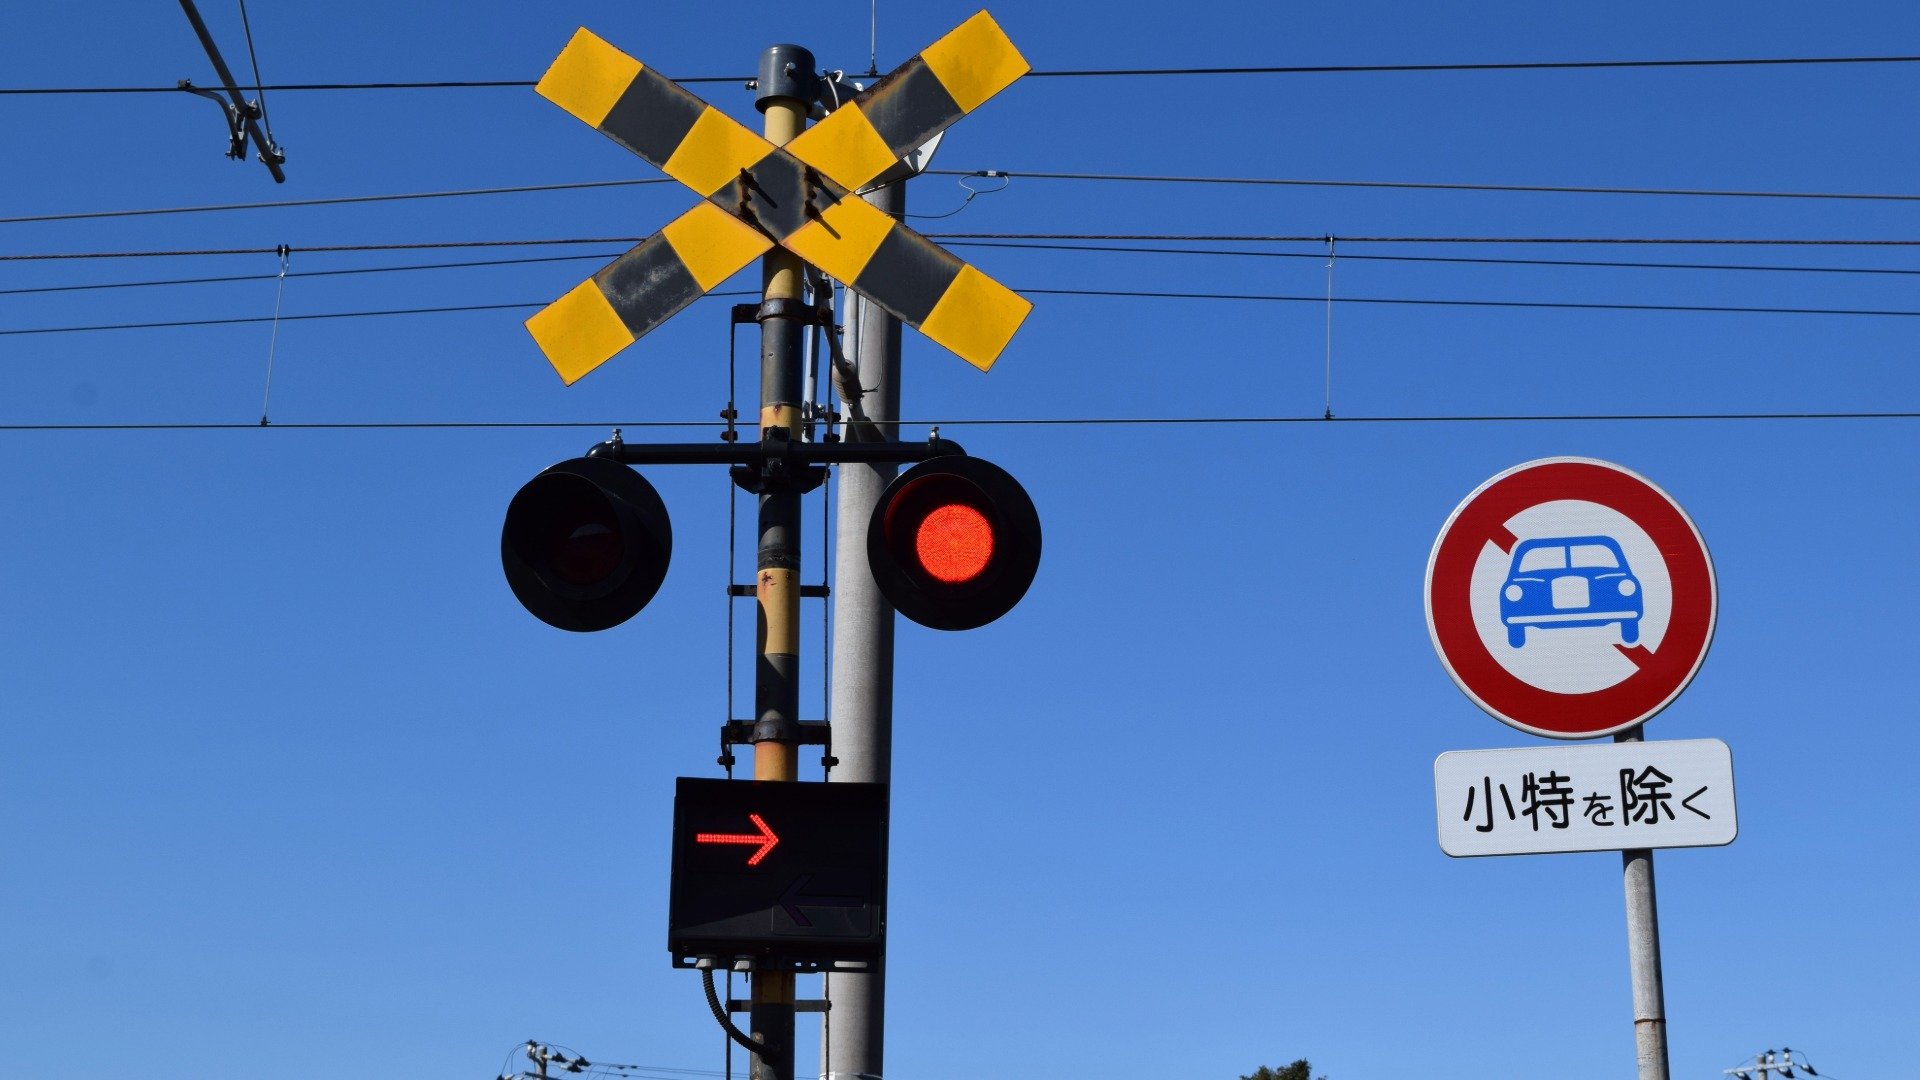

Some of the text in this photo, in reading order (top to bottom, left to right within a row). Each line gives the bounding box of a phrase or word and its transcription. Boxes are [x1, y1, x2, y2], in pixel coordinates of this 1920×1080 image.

[1463, 765, 1711, 832] 小特を除く
